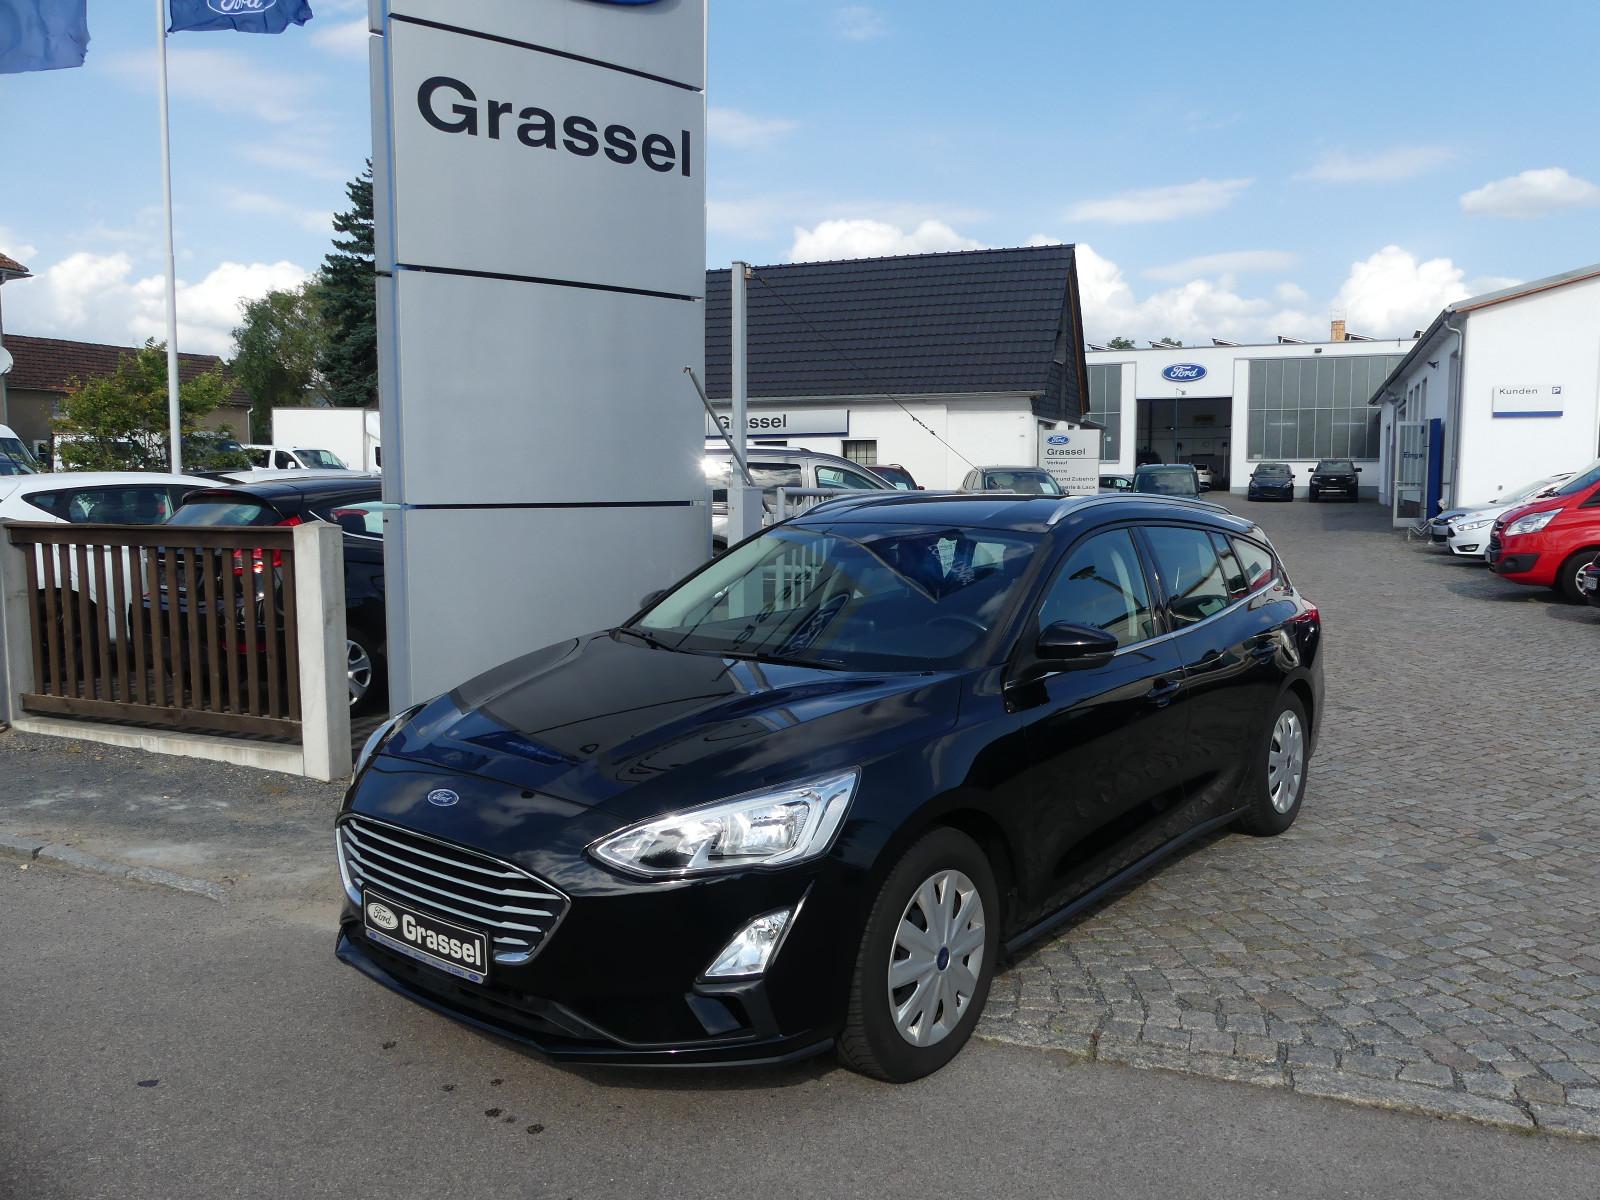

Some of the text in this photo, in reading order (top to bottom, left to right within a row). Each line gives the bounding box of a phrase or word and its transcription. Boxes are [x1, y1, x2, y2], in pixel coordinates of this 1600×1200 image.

[417, 75, 691, 177] Grassel
[1170, 366, 1198, 377] Ford
[1499, 387, 1538, 395] Kunden
[718, 413, 787, 429] Gssel
[373, 906, 392, 925] Ford
[402, 914, 481, 966] Grassel
